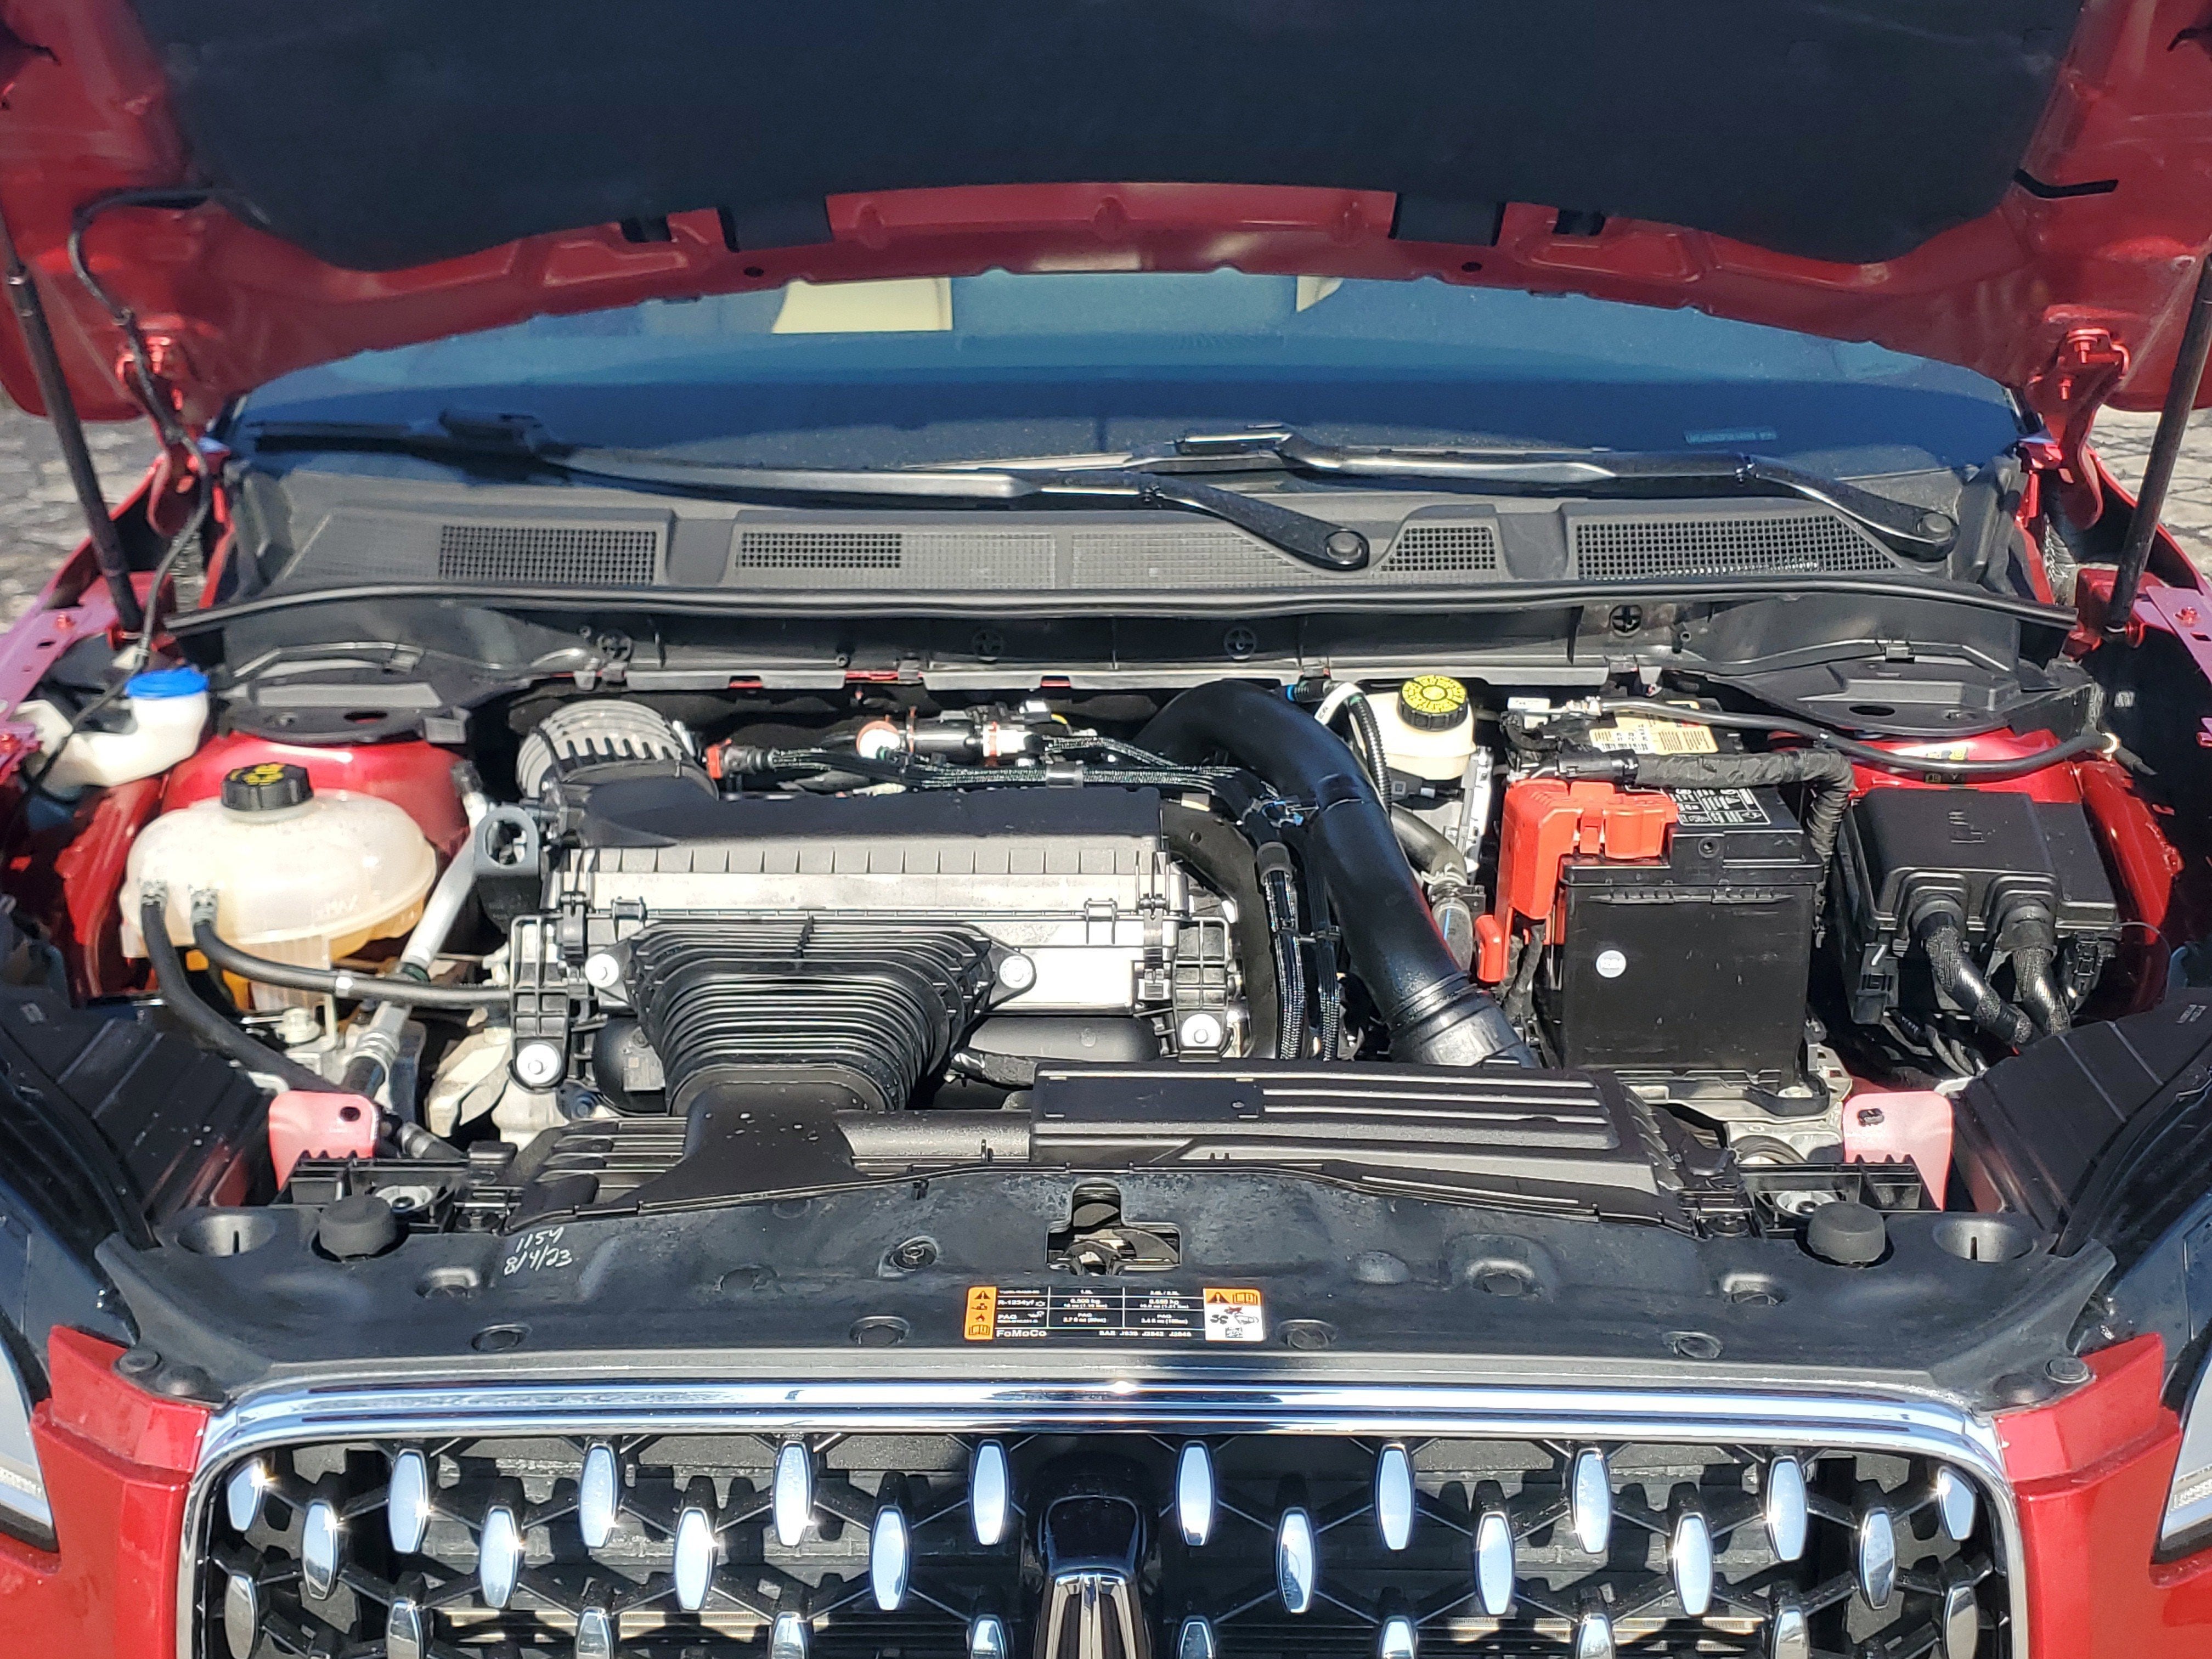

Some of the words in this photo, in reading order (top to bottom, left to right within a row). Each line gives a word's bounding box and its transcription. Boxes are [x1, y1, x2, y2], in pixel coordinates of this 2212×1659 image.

[515, 1226, 565, 1254] 1154
[503, 1244, 573, 1277] 8/4/23
[996, 1329, 1047, 1338] FoMoCo
